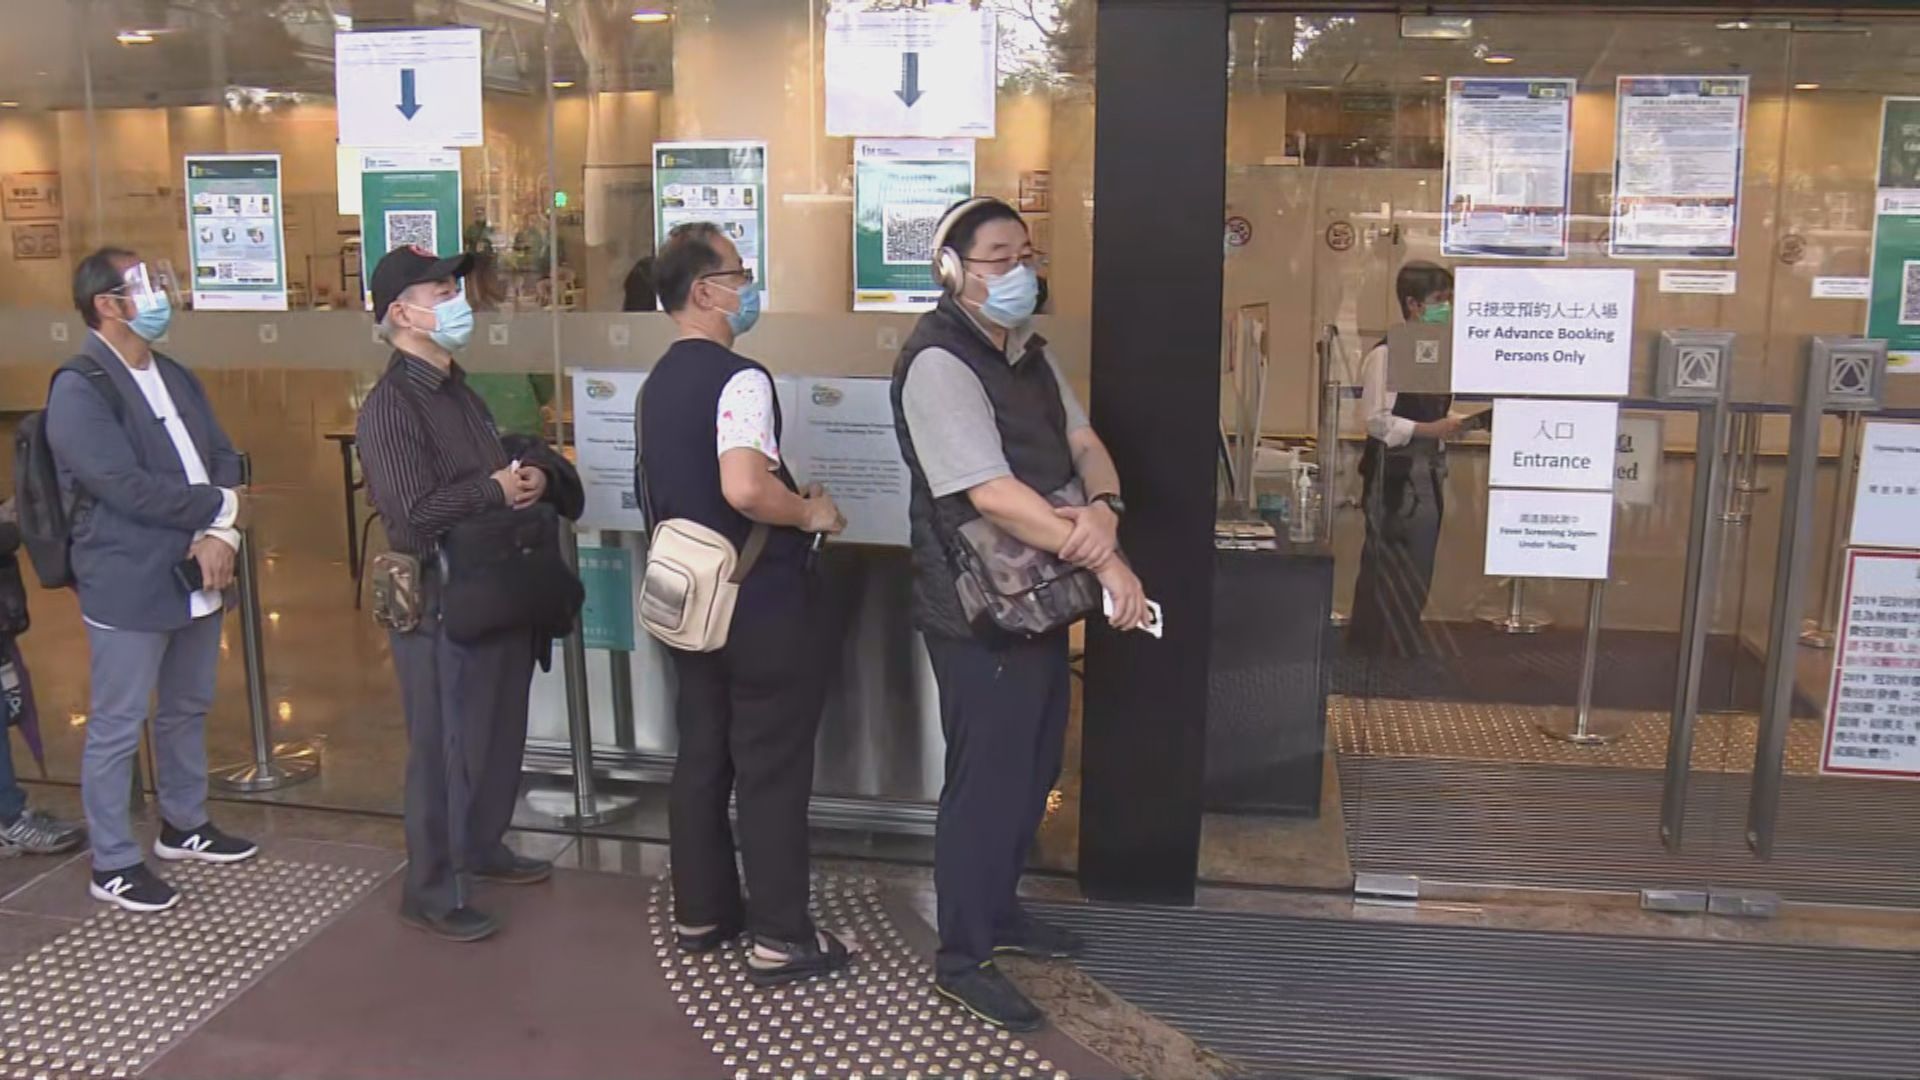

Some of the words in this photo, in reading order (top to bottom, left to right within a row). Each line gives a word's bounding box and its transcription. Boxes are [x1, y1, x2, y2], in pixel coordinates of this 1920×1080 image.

[1468, 326, 1491, 339] For
[1494, 326, 1554, 340] Advance
[1557, 327, 1616, 343] Booking
[1494, 349, 1549, 363] Persons
[1552, 350, 1586, 366] Only
[1534, 420, 1575, 440] 入口
[1512, 451, 1592, 469] Entrance
